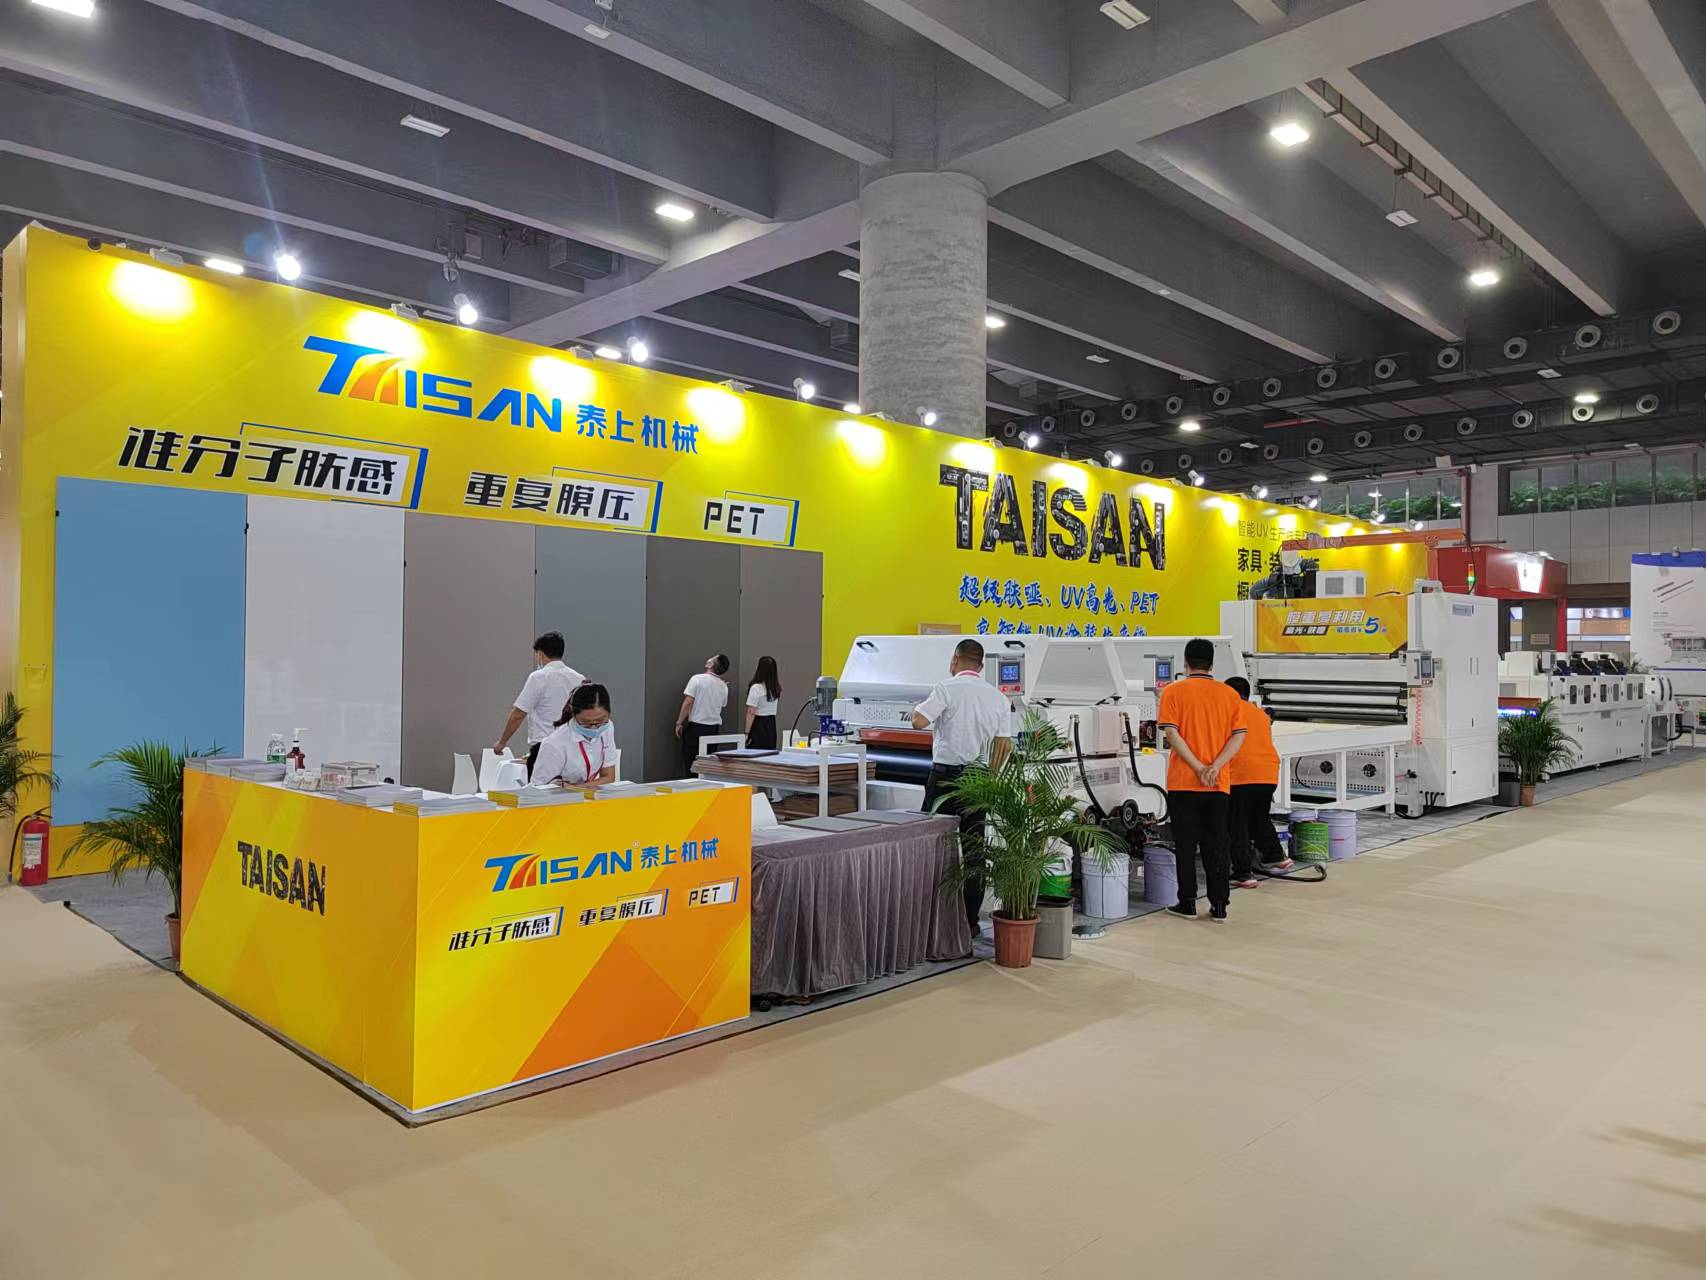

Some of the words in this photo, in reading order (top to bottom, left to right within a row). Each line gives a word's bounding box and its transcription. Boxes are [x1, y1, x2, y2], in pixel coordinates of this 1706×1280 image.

[303, 335, 562, 432] TAISAN
[576, 403, 699, 454] 泰上机械
[118, 426, 398, 495] 准分子肤感
[463, 471, 636, 521] 重复膜压
[703, 501, 765, 536] PET
[939, 463, 1167, 571] TAISAN
[237, 840, 326, 916] TAISAN
[484, 849, 632, 892] TAISAN
[641, 837, 719, 869] 泰上机械
[448, 916, 552, 951] 准分子肤感
[579, 898, 656, 927] 重复膜压
[688, 886, 721, 906] PET
